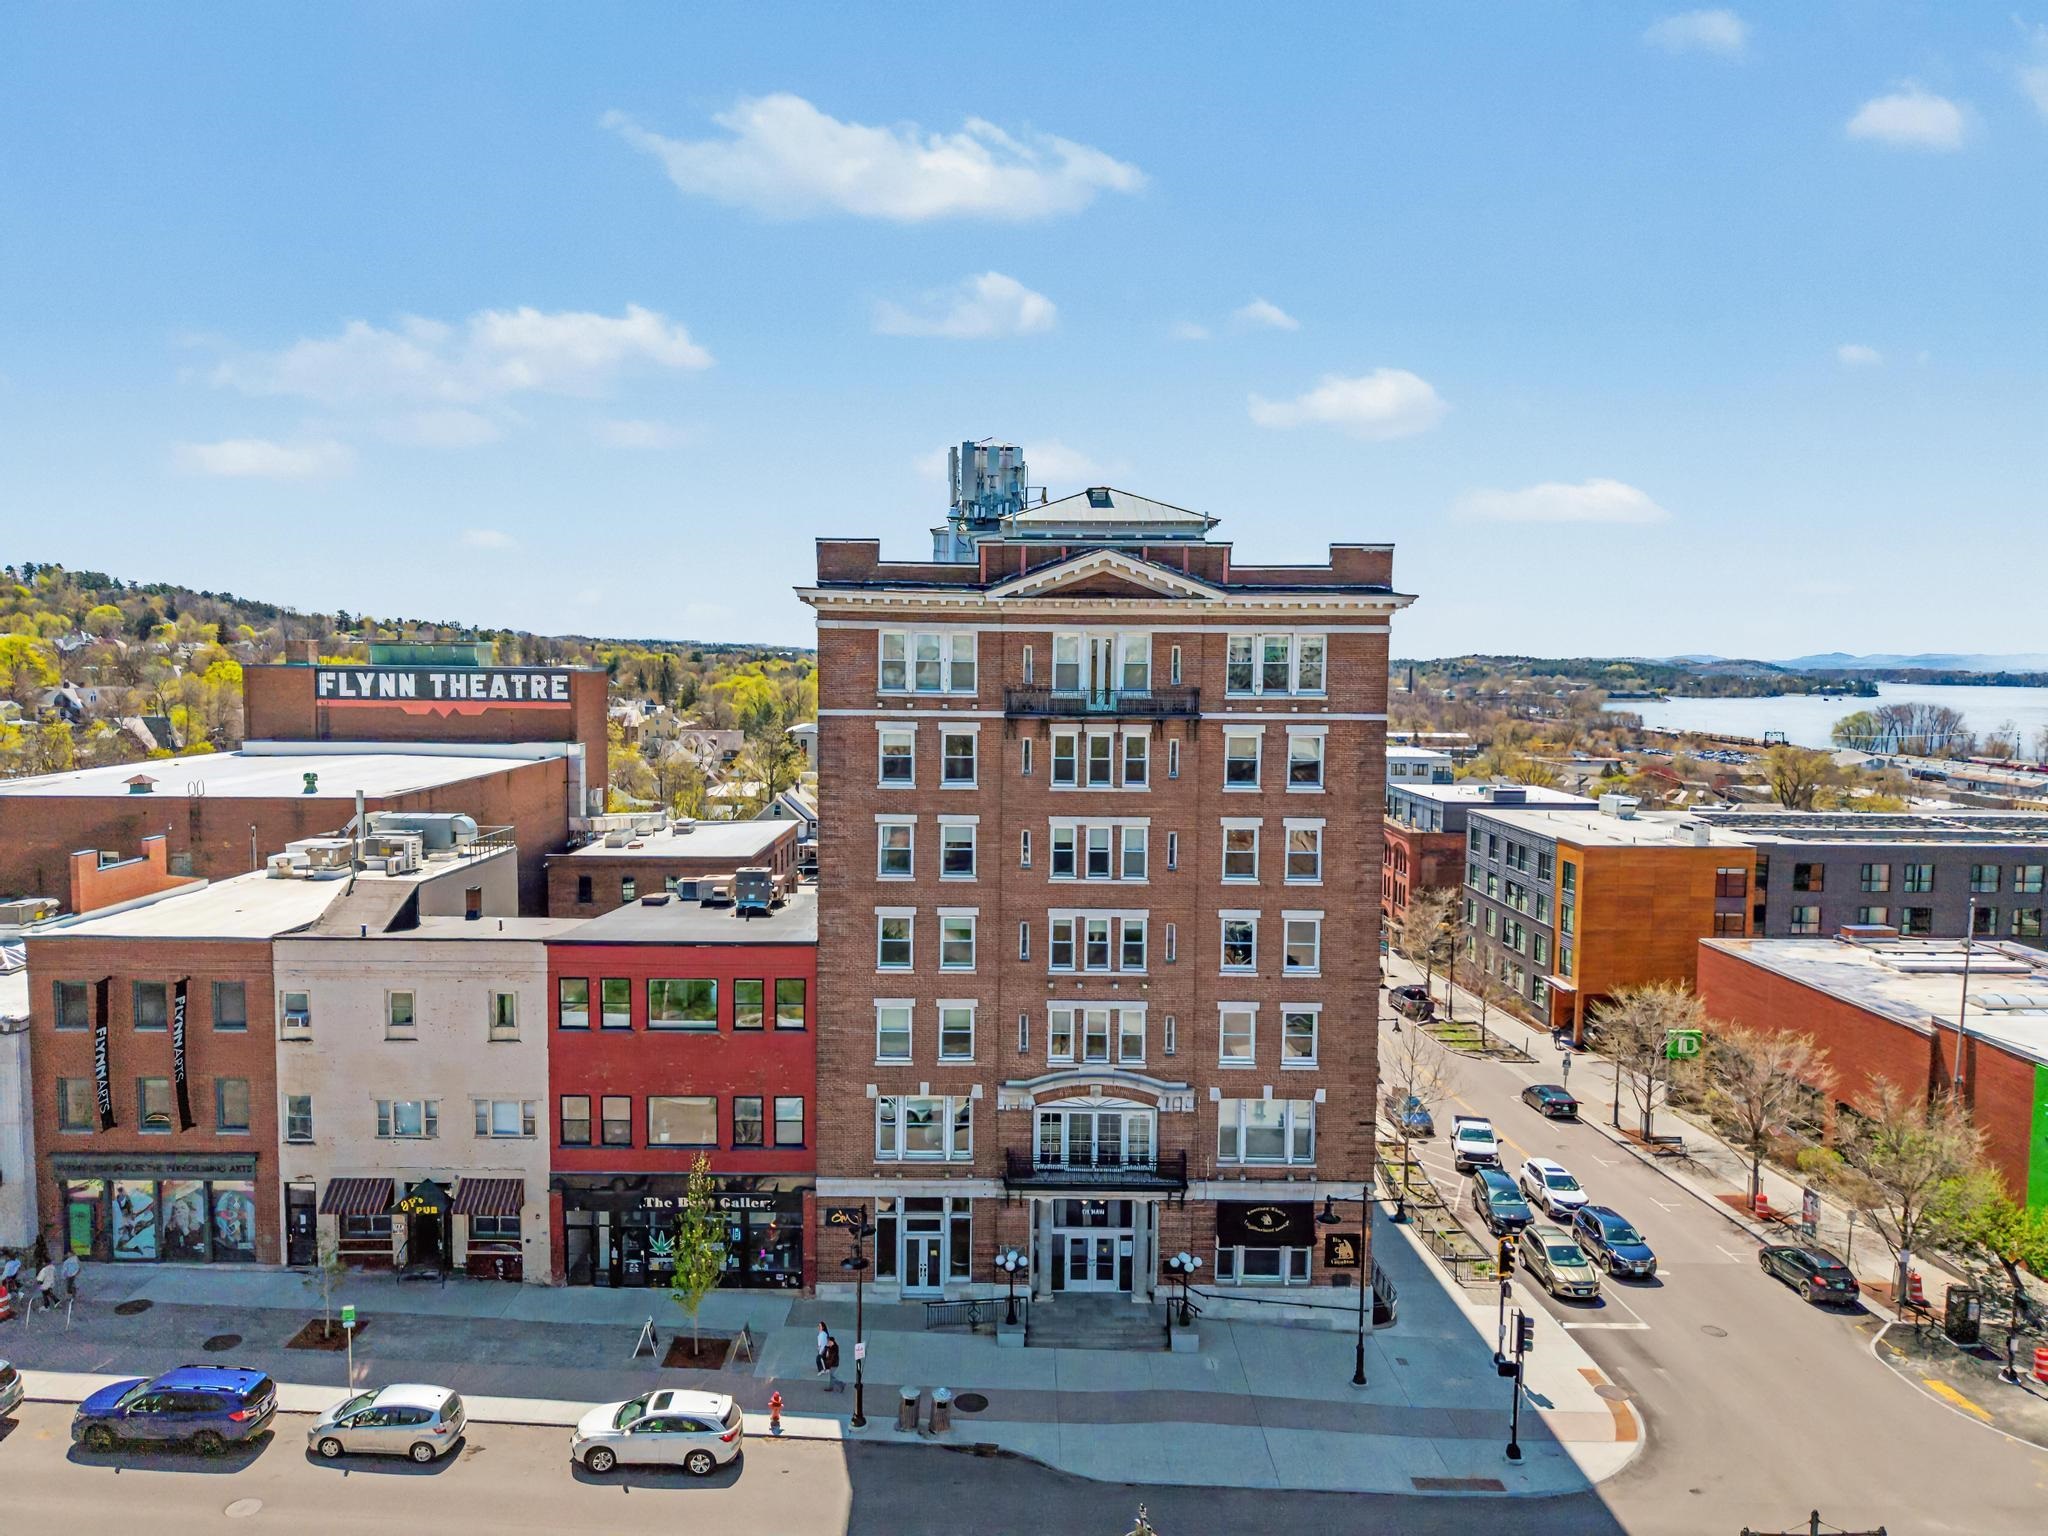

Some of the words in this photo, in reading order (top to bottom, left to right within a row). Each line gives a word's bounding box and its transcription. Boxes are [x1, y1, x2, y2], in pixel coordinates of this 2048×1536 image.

[319, 672, 416, 698] FLYNN
[430, 673, 568, 700] THEATRE
[643, 1197, 673, 1208] The
[416, 1206, 438, 1215] PUB
